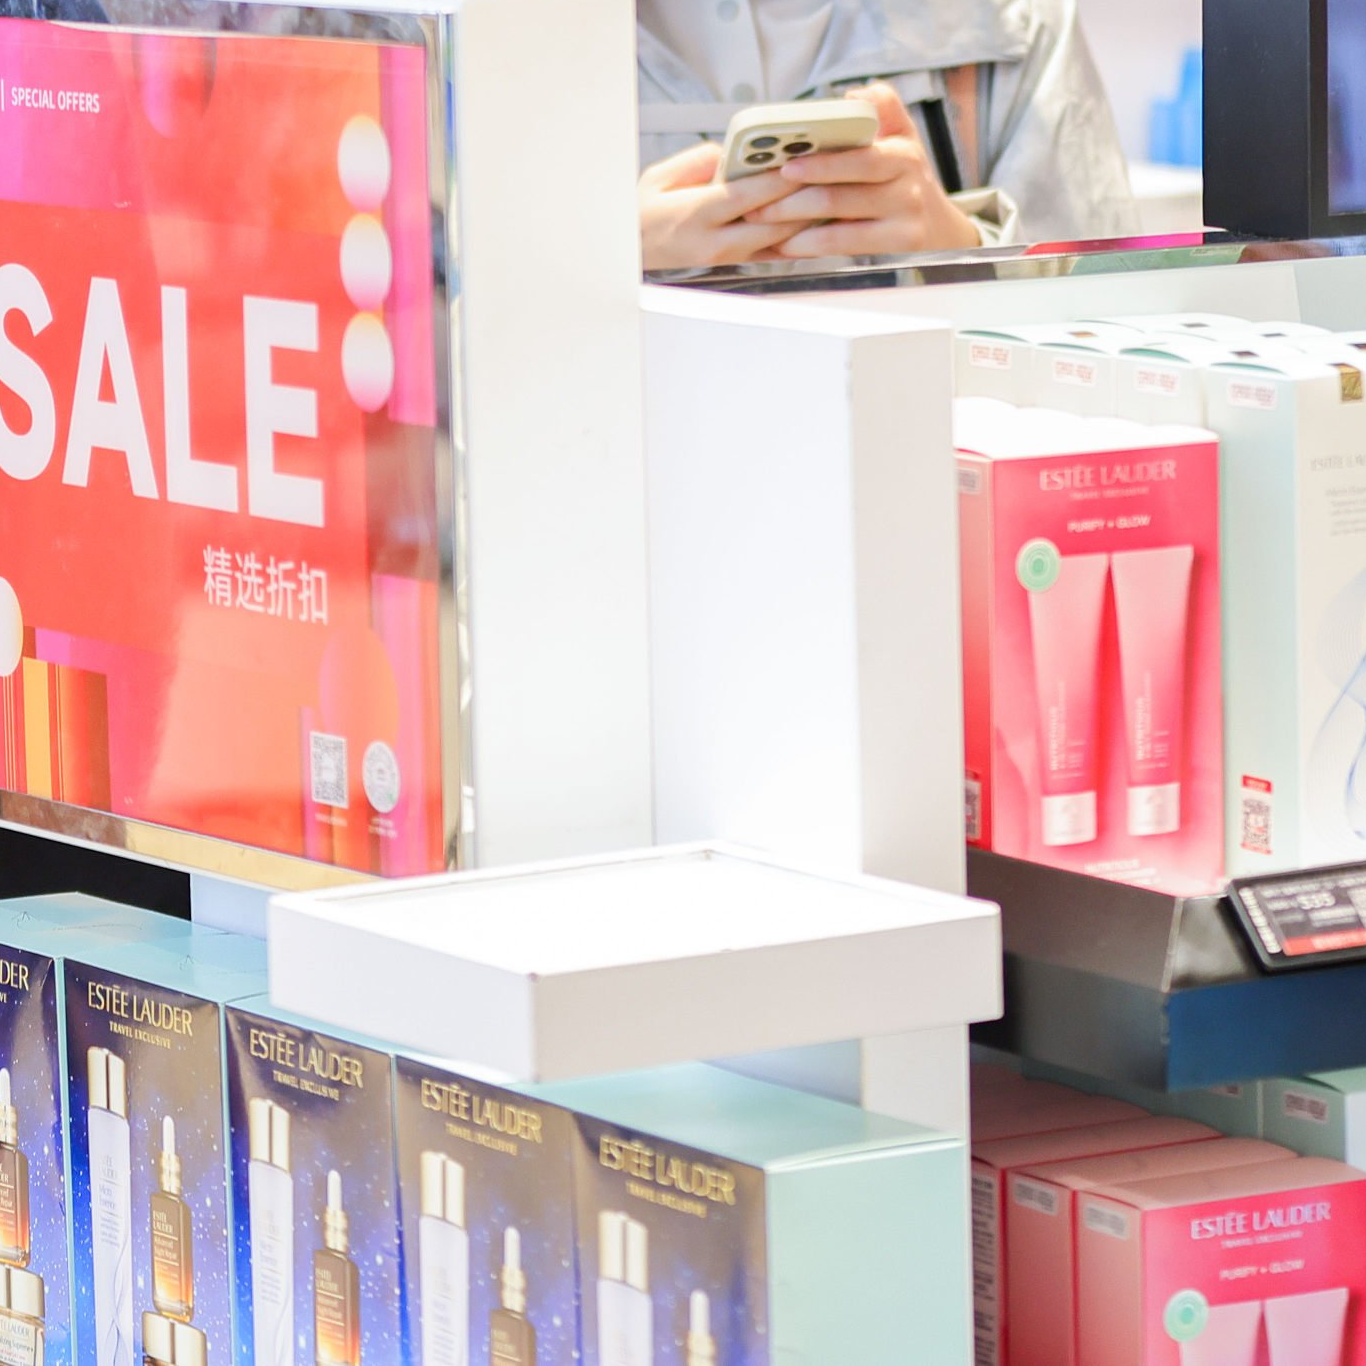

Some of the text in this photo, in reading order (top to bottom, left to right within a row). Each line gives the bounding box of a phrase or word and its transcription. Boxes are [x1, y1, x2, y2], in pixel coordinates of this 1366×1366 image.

[11, 87, 100, 113] SPECIAL OFFERS
[1100, 459, 1177, 485] LAUDER
[203, 545, 329, 625] 精选折扣
[88, 981, 193, 1037] ESTÉE LAUDER
[109, 1020, 172, 1049] TRAVEL EXCLUSIVE
[249, 1028, 363, 1090] ESTÉE LAUDER
[272, 1069, 340, 1102] TRAVEL EXCLUSIVE
[420, 1078, 544, 1145] ESTÉE LAUDER
[655, 1152, 736, 1207] LAUDER
[1190, 1201, 1332, 1240] ESTÉE LAUDER
